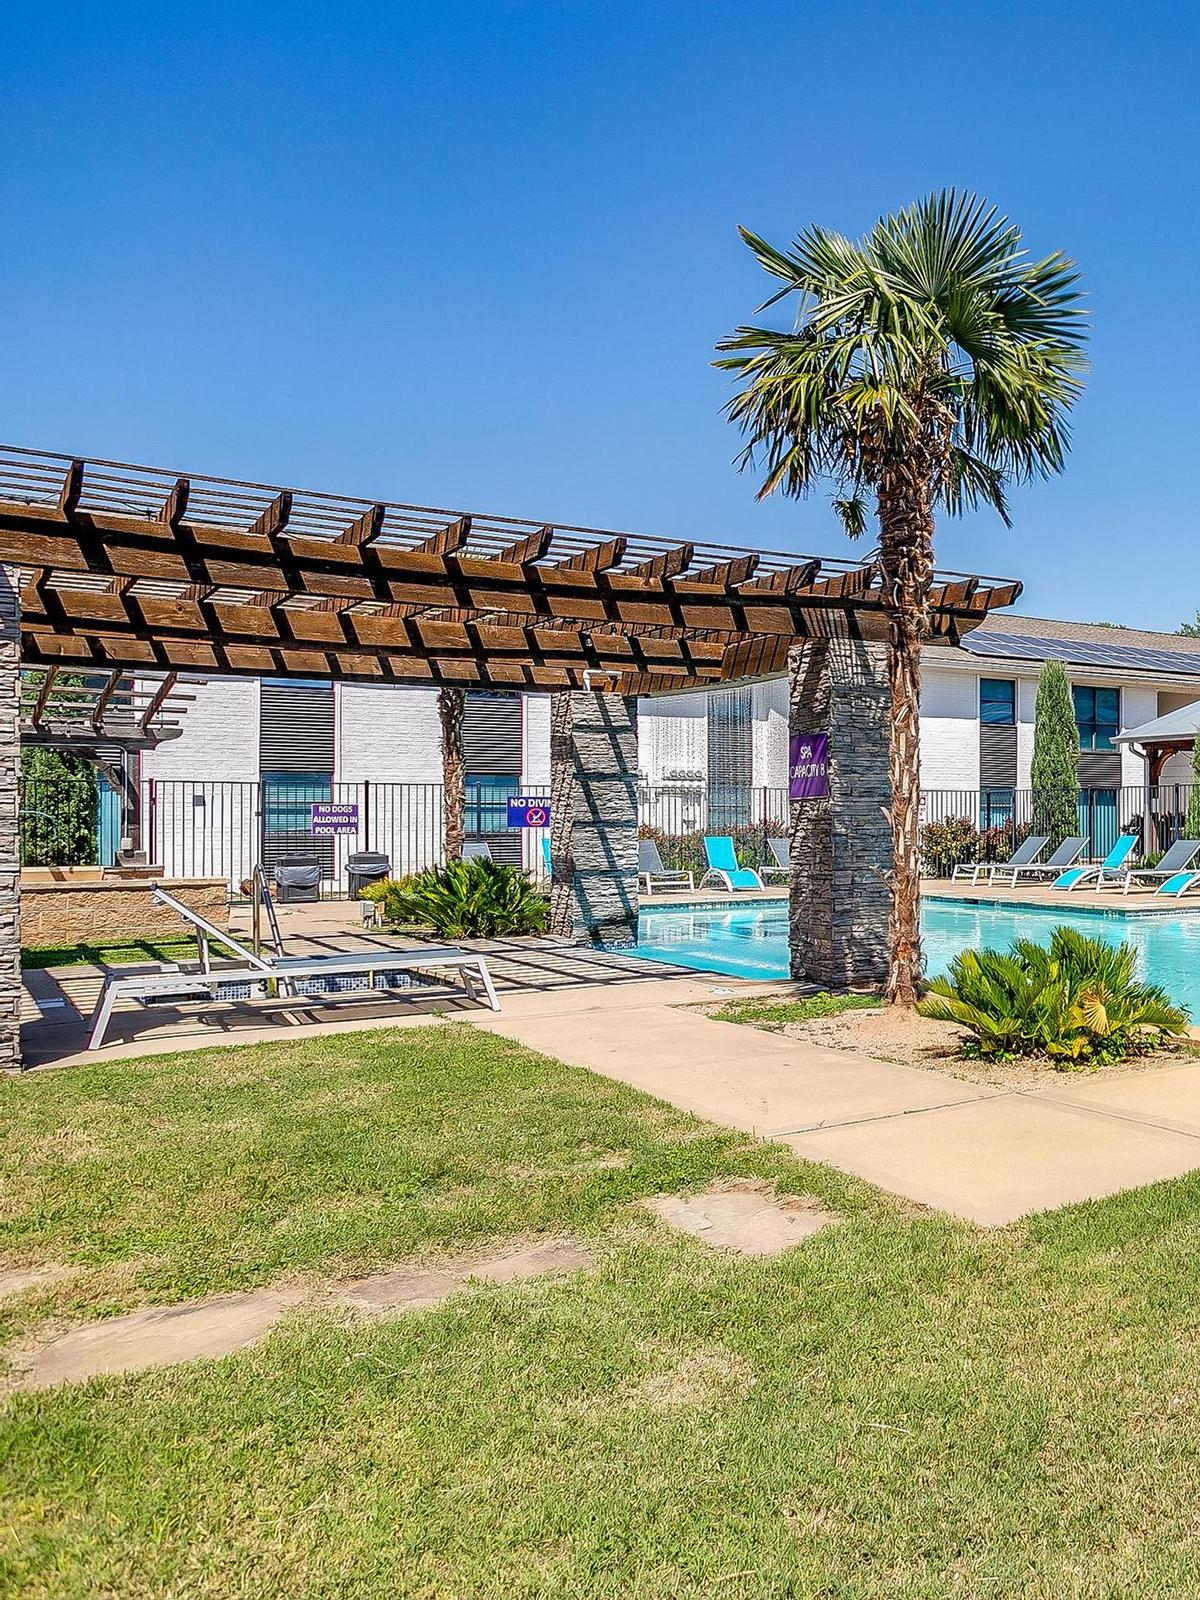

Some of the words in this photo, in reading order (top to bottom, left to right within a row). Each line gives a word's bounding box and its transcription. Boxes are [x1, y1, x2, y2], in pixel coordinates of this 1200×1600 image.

[800, 746, 812, 759] SPA
[790, 764, 819, 779] CAPACITY
[510, 799, 526, 808] NO
[528, 798, 552, 808] DIVIN
